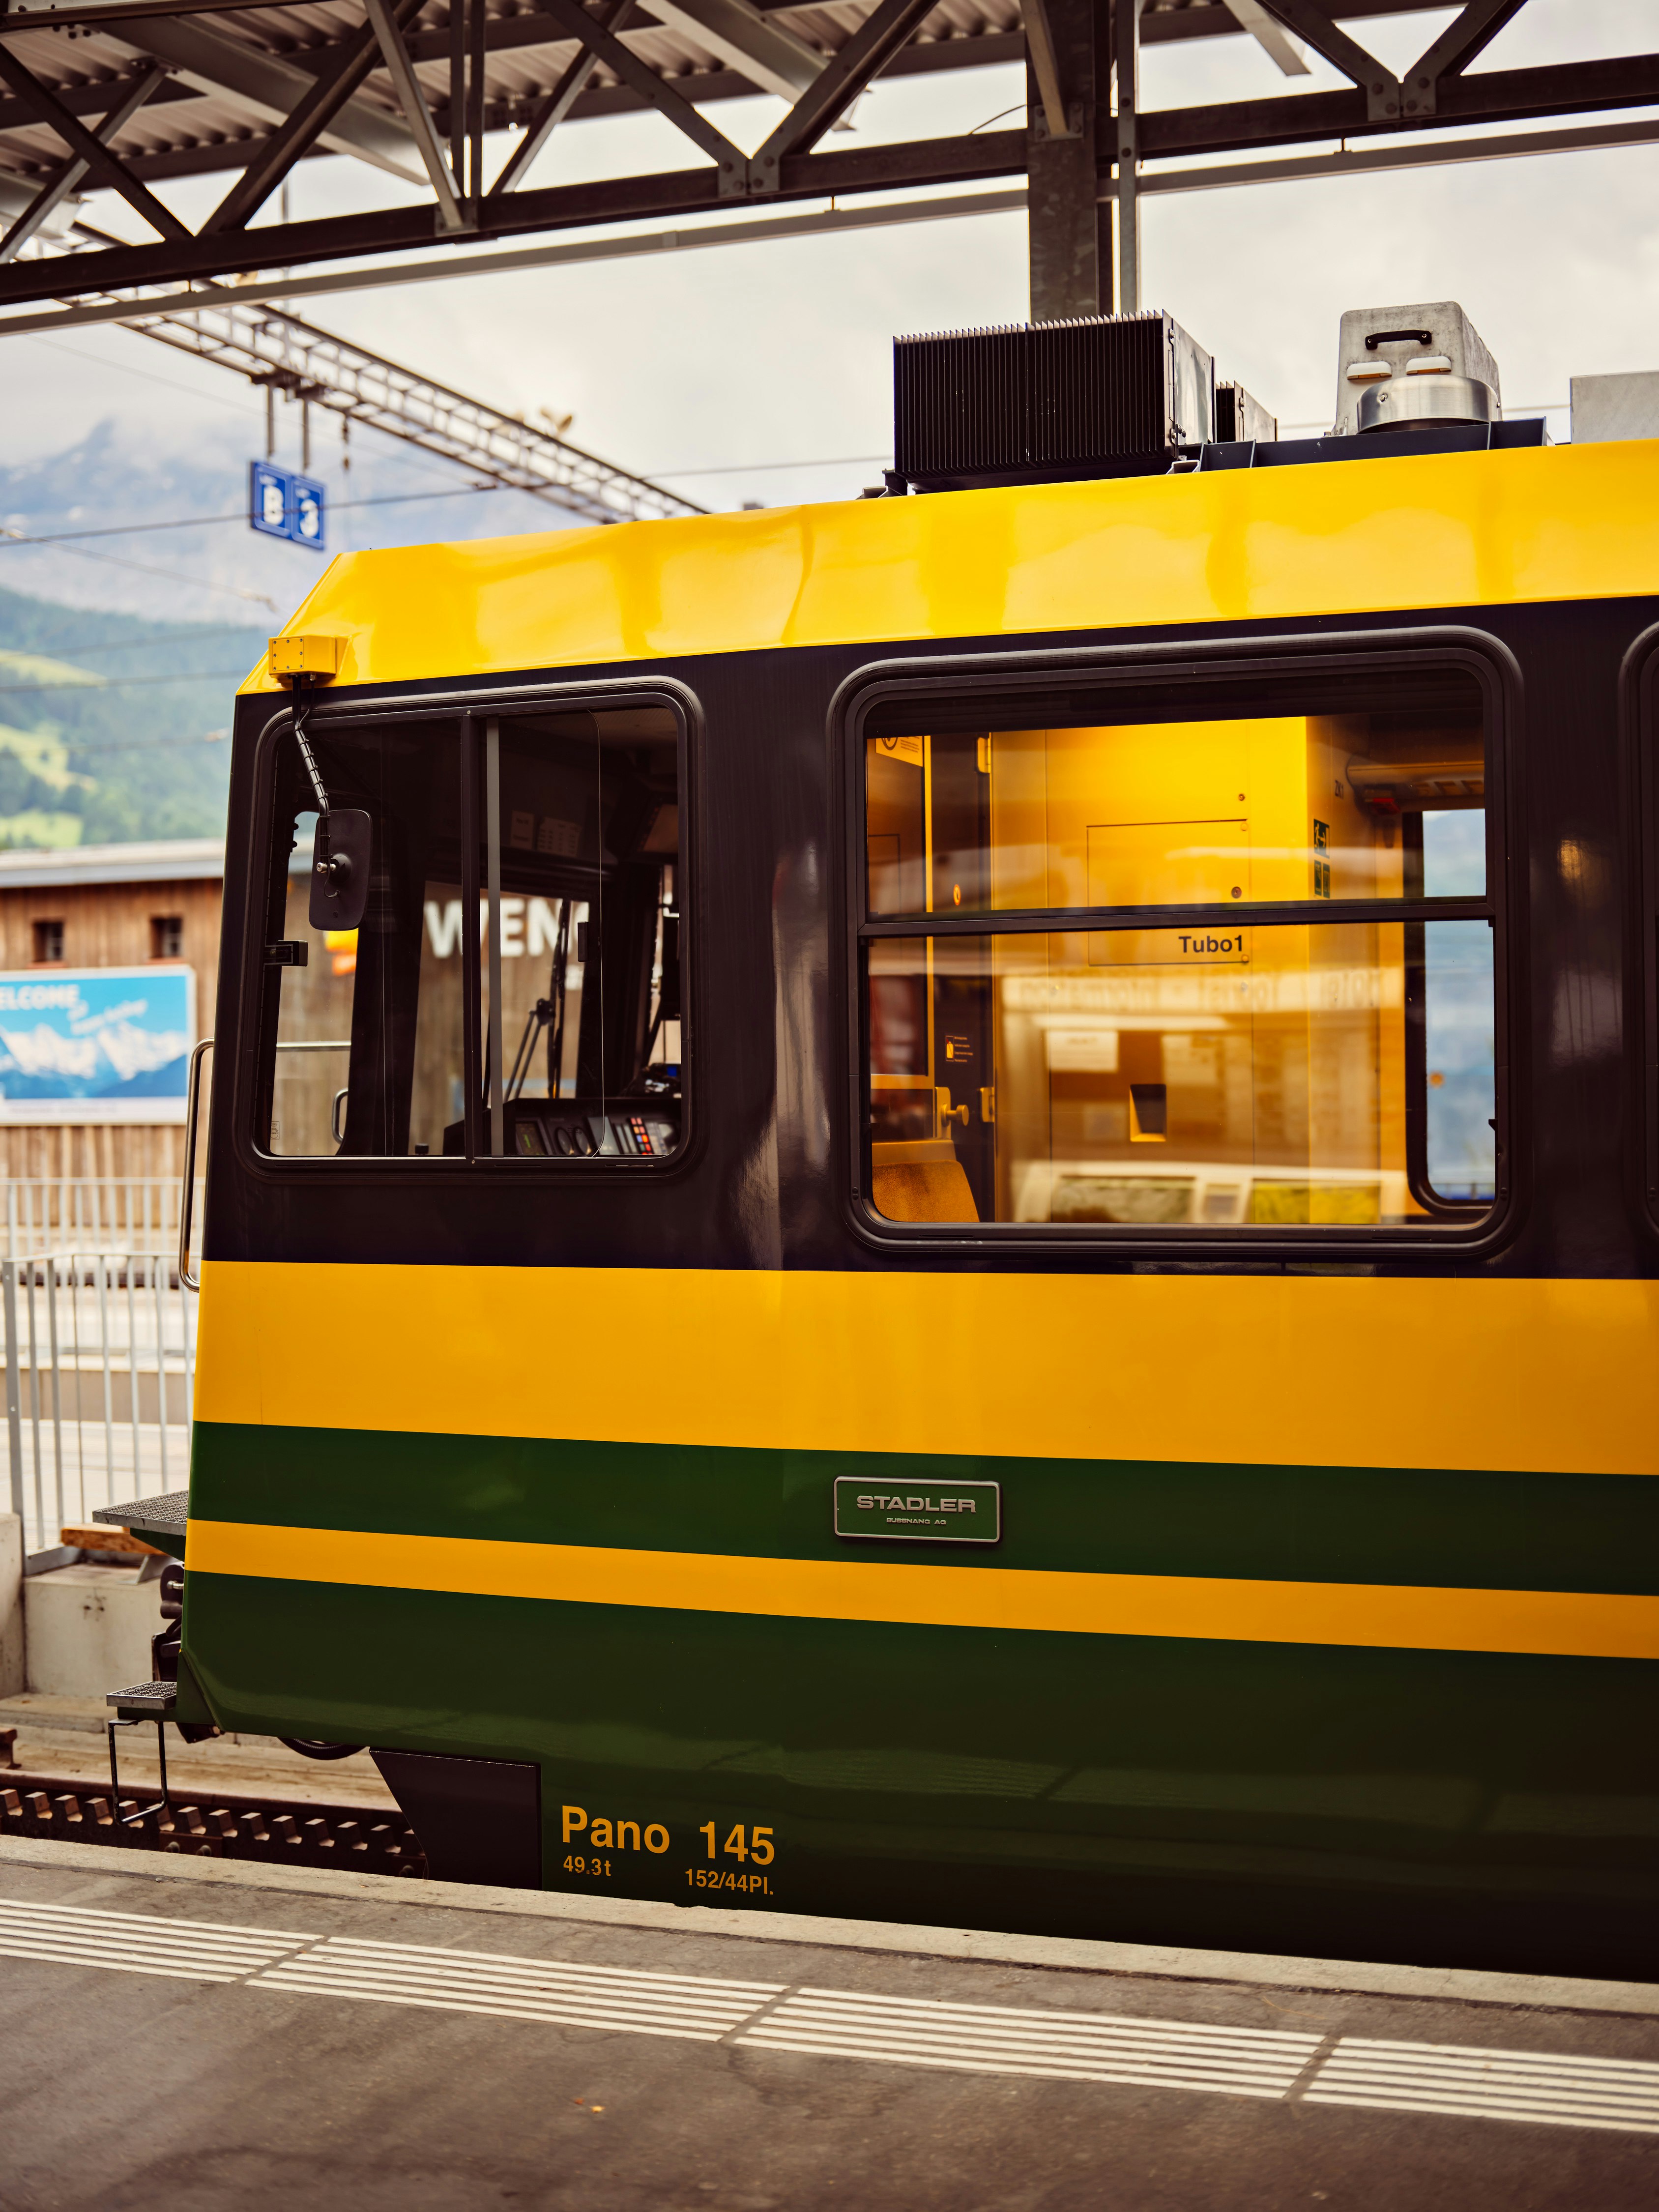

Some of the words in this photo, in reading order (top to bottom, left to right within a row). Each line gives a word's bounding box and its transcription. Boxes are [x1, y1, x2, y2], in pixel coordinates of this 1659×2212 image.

[263, 485, 284, 525] B
[299, 499, 319, 538] 3
[424, 898, 589, 958] WEN
[1178, 935, 1242, 953] Tubo1
[0, 984, 80, 1011] ELCOME
[857, 1495, 976, 1513] STADLER
[562, 1805, 670, 1854] Pano
[699, 1821, 775, 1865] 145
[563, 1855, 611, 1877] 49.3t
